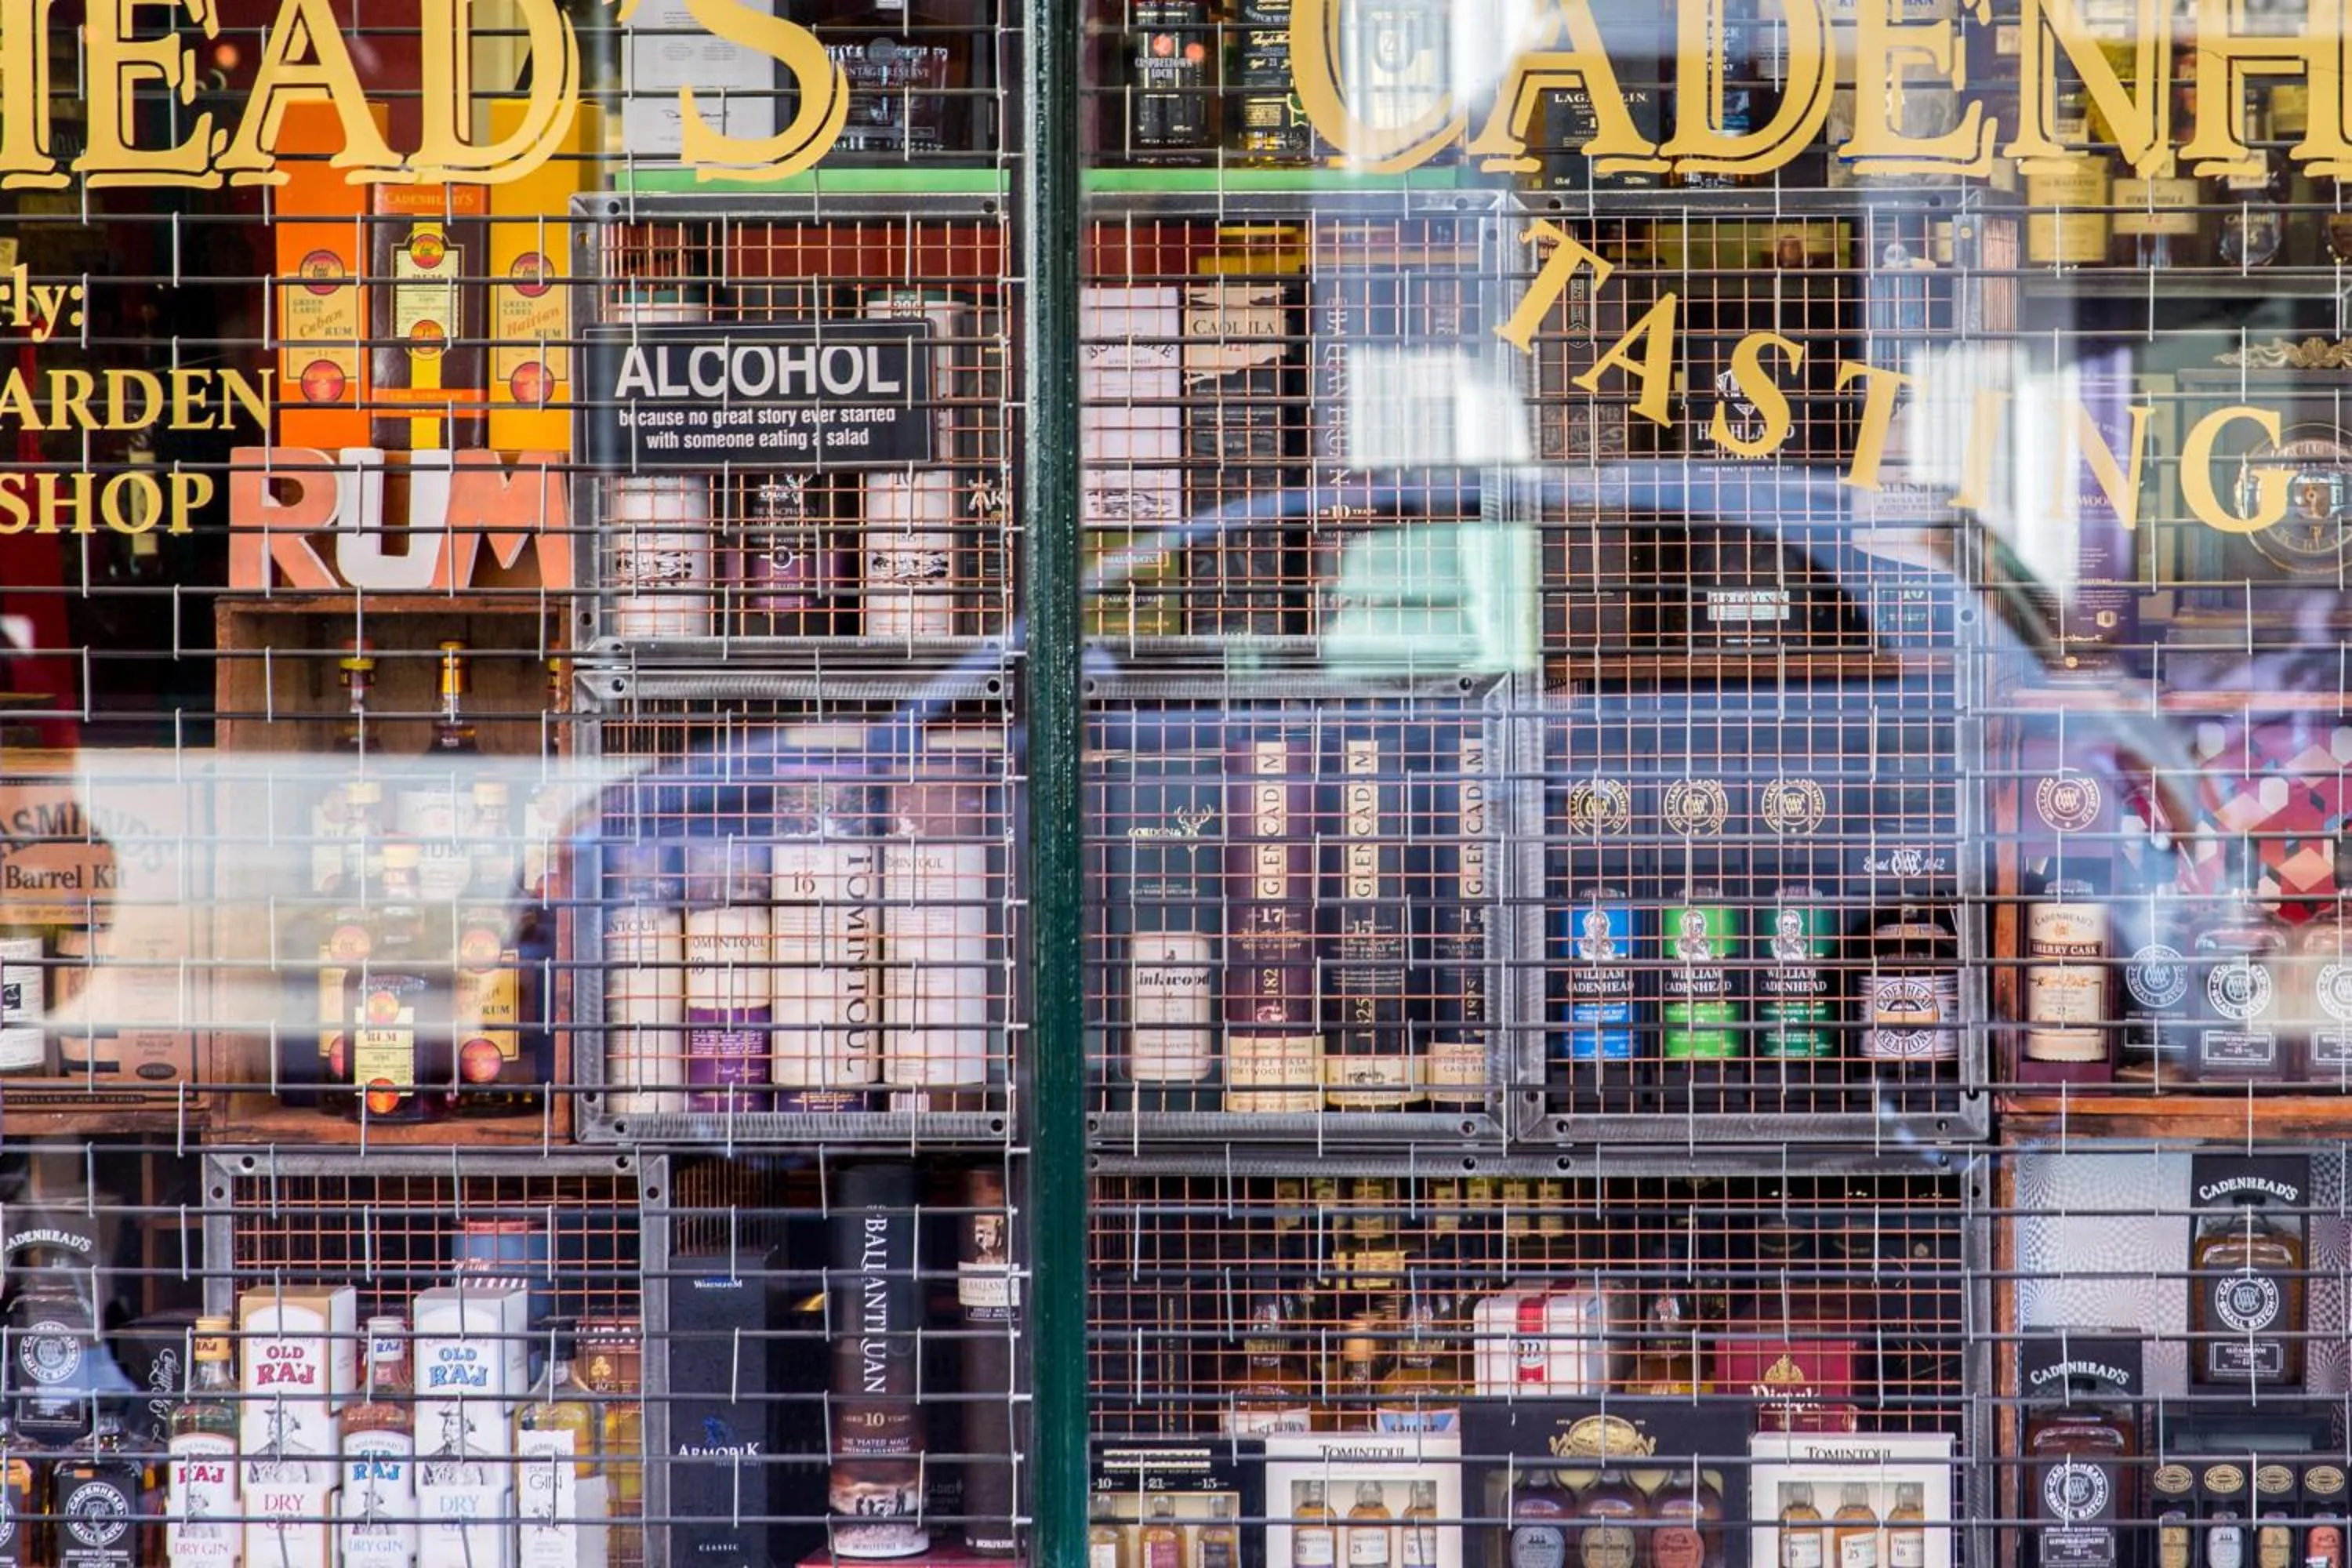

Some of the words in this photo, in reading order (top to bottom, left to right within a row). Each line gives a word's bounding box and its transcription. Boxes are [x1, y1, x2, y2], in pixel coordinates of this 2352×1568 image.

[0, 0, 849, 186] EADS
[1555, 92, 1648, 103] LAGLIN
[383, 193, 474, 206] CADENHED'S
[325, 326, 352, 336] RUM
[1192, 320, 1243, 335] CAOL
[615, 345, 900, 398] ALCOHOL
[1492, 217, 2297, 535] TASTING
[689, 411, 708, 426] no
[713, 408, 753, 428] great
[758, 406, 797, 427] story
[801, 408, 835, 423] ever
[840, 407, 896, 423] started
[647, 432, 679, 449] with
[684, 431, 754, 448] someone
[759, 429, 808, 451] eating
[827, 428, 869, 446] salad
[1697, 422, 1795, 440] HHLAD
[0, 472, 214, 535] SHOP
[229, 448, 572, 590] RUM
[1263, 754, 1280, 895] GLENCADM
[1354, 750, 1371, 898] GLENCADM
[1466, 748, 1483, 895] GLENCADM
[5, 865, 82, 889] Barrel
[791, 871, 816, 894] 16
[1261, 907, 1282, 924] 17
[2071, 943, 2098, 955] CASK
[846, 845, 873, 1073] TOMINTOUL
[1136, 970, 1210, 987] inkwood
[1263, 967, 1279, 996] 182
[482, 1005, 510, 1015] RUM
[1356, 996, 1373, 1038] 125
[2199, 1177, 2299, 1201] CADENHEAD'S
[5, 1229, 93, 1253] ADENHEAD'S
[266, 1345, 304, 1359] OLD
[438, 1347, 477, 1362] OLD
[256, 1361, 316, 1386] RAJ
[429, 1363, 488, 1388] RAJ
[2030, 1361, 2129, 1385] CADENHEAD'S
[865, 1412, 885, 1427] 10
[890, 1438, 909, 1446] MALT
[1318, 1443, 1405, 1458] TOMINTOUL
[1805, 1446, 1892, 1459] TOMINTOUL
[353, 1461, 401, 1481] RAJ
[528, 1473, 563, 1490] GIN
[1097, 1477, 1112, 1490] 10
[1147, 1477, 1166, 1490] 21
[1201, 1477, 1218, 1490] 15
[69, 1484, 124, 1512] CADENHEAD
[264, 1494, 305, 1512] DRY
[439, 1495, 479, 1513] DRY
[174, 1542, 201, 1555] DRY
[202, 1542, 229, 1555] GIN
[349, 1539, 376, 1552] DRY
[376, 1539, 403, 1552] GIN
[699, 1543, 739, 1552] CLASSIC
[1847, 1548, 1860, 1559] 25
[1896, 1548, 1907, 1558] 16
